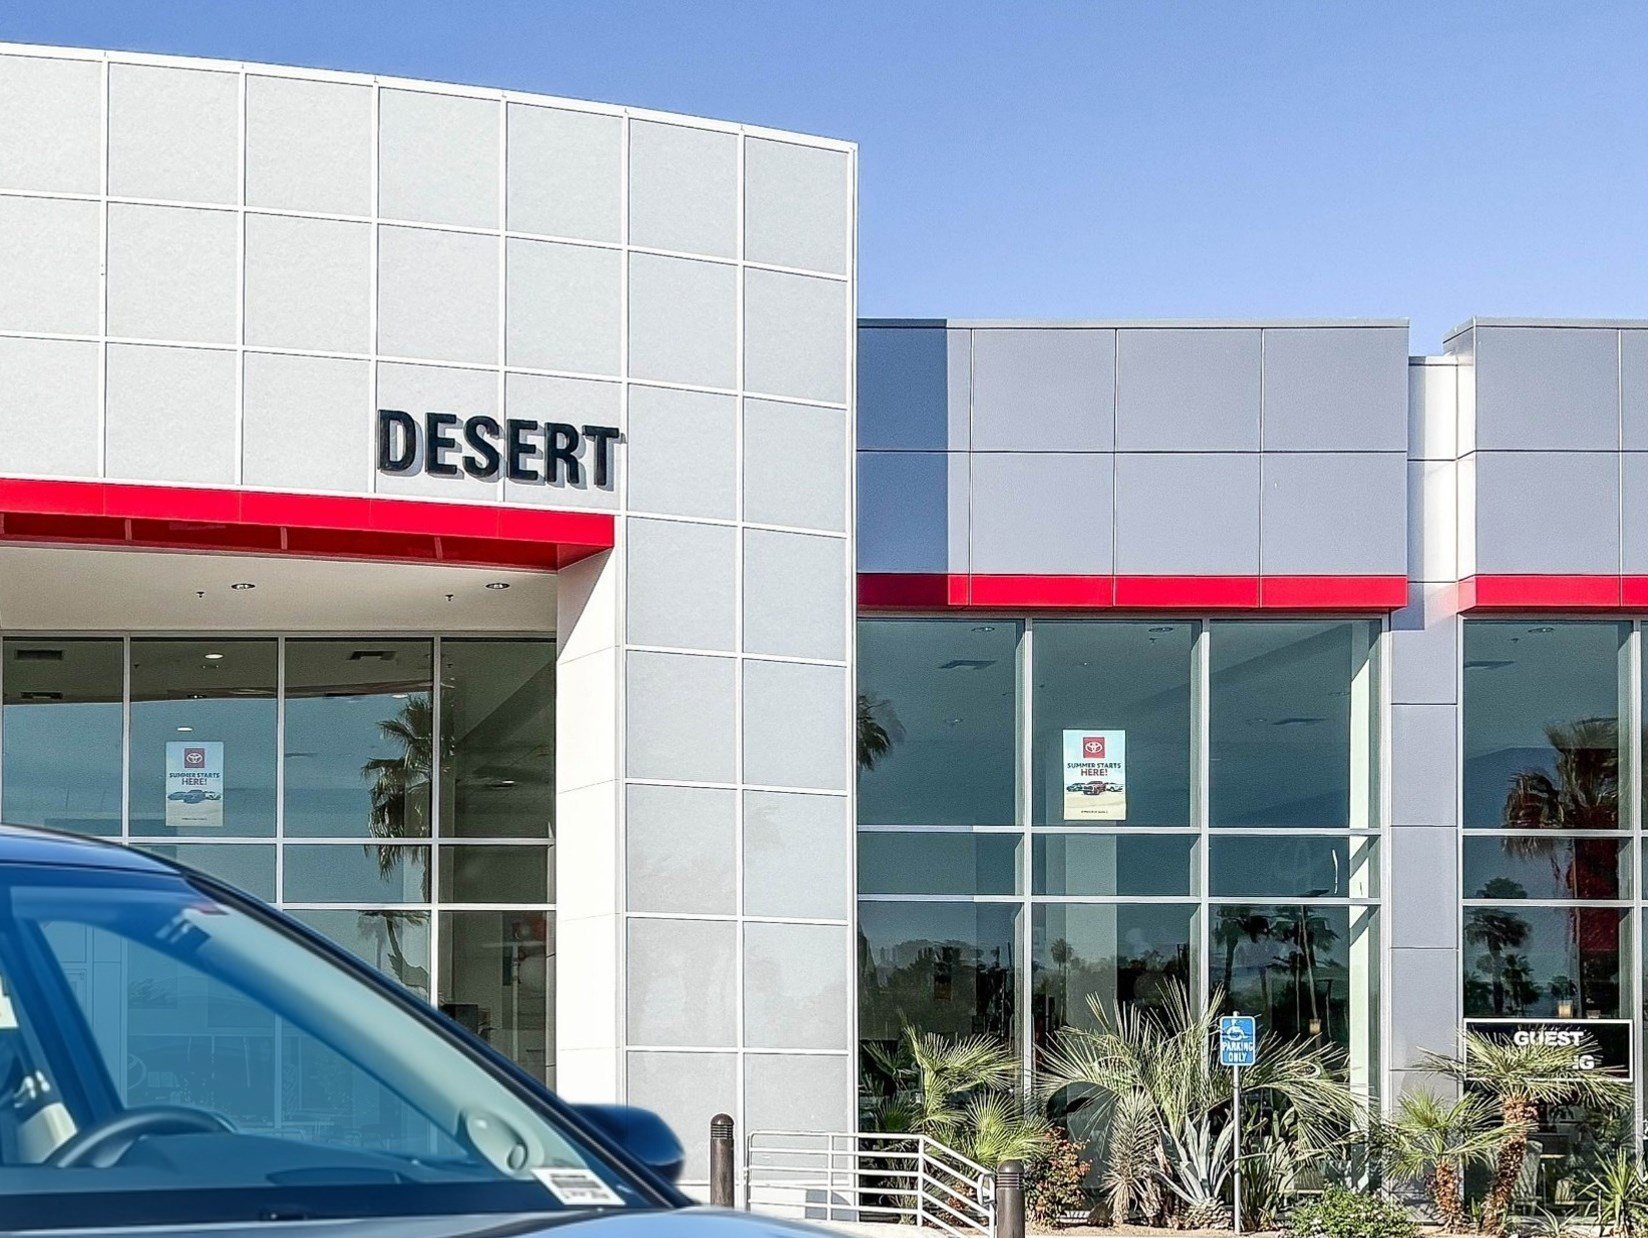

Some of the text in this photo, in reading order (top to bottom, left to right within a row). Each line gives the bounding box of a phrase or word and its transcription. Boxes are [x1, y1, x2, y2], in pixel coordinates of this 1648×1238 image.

[377, 409, 620, 487] DESERT
[181, 778, 208, 786] HERE!
[1513, 1031, 1585, 1047] GUEST
[1222, 1041, 1253, 1051] PARKING
[1228, 1052, 1248, 1062] ONLY
